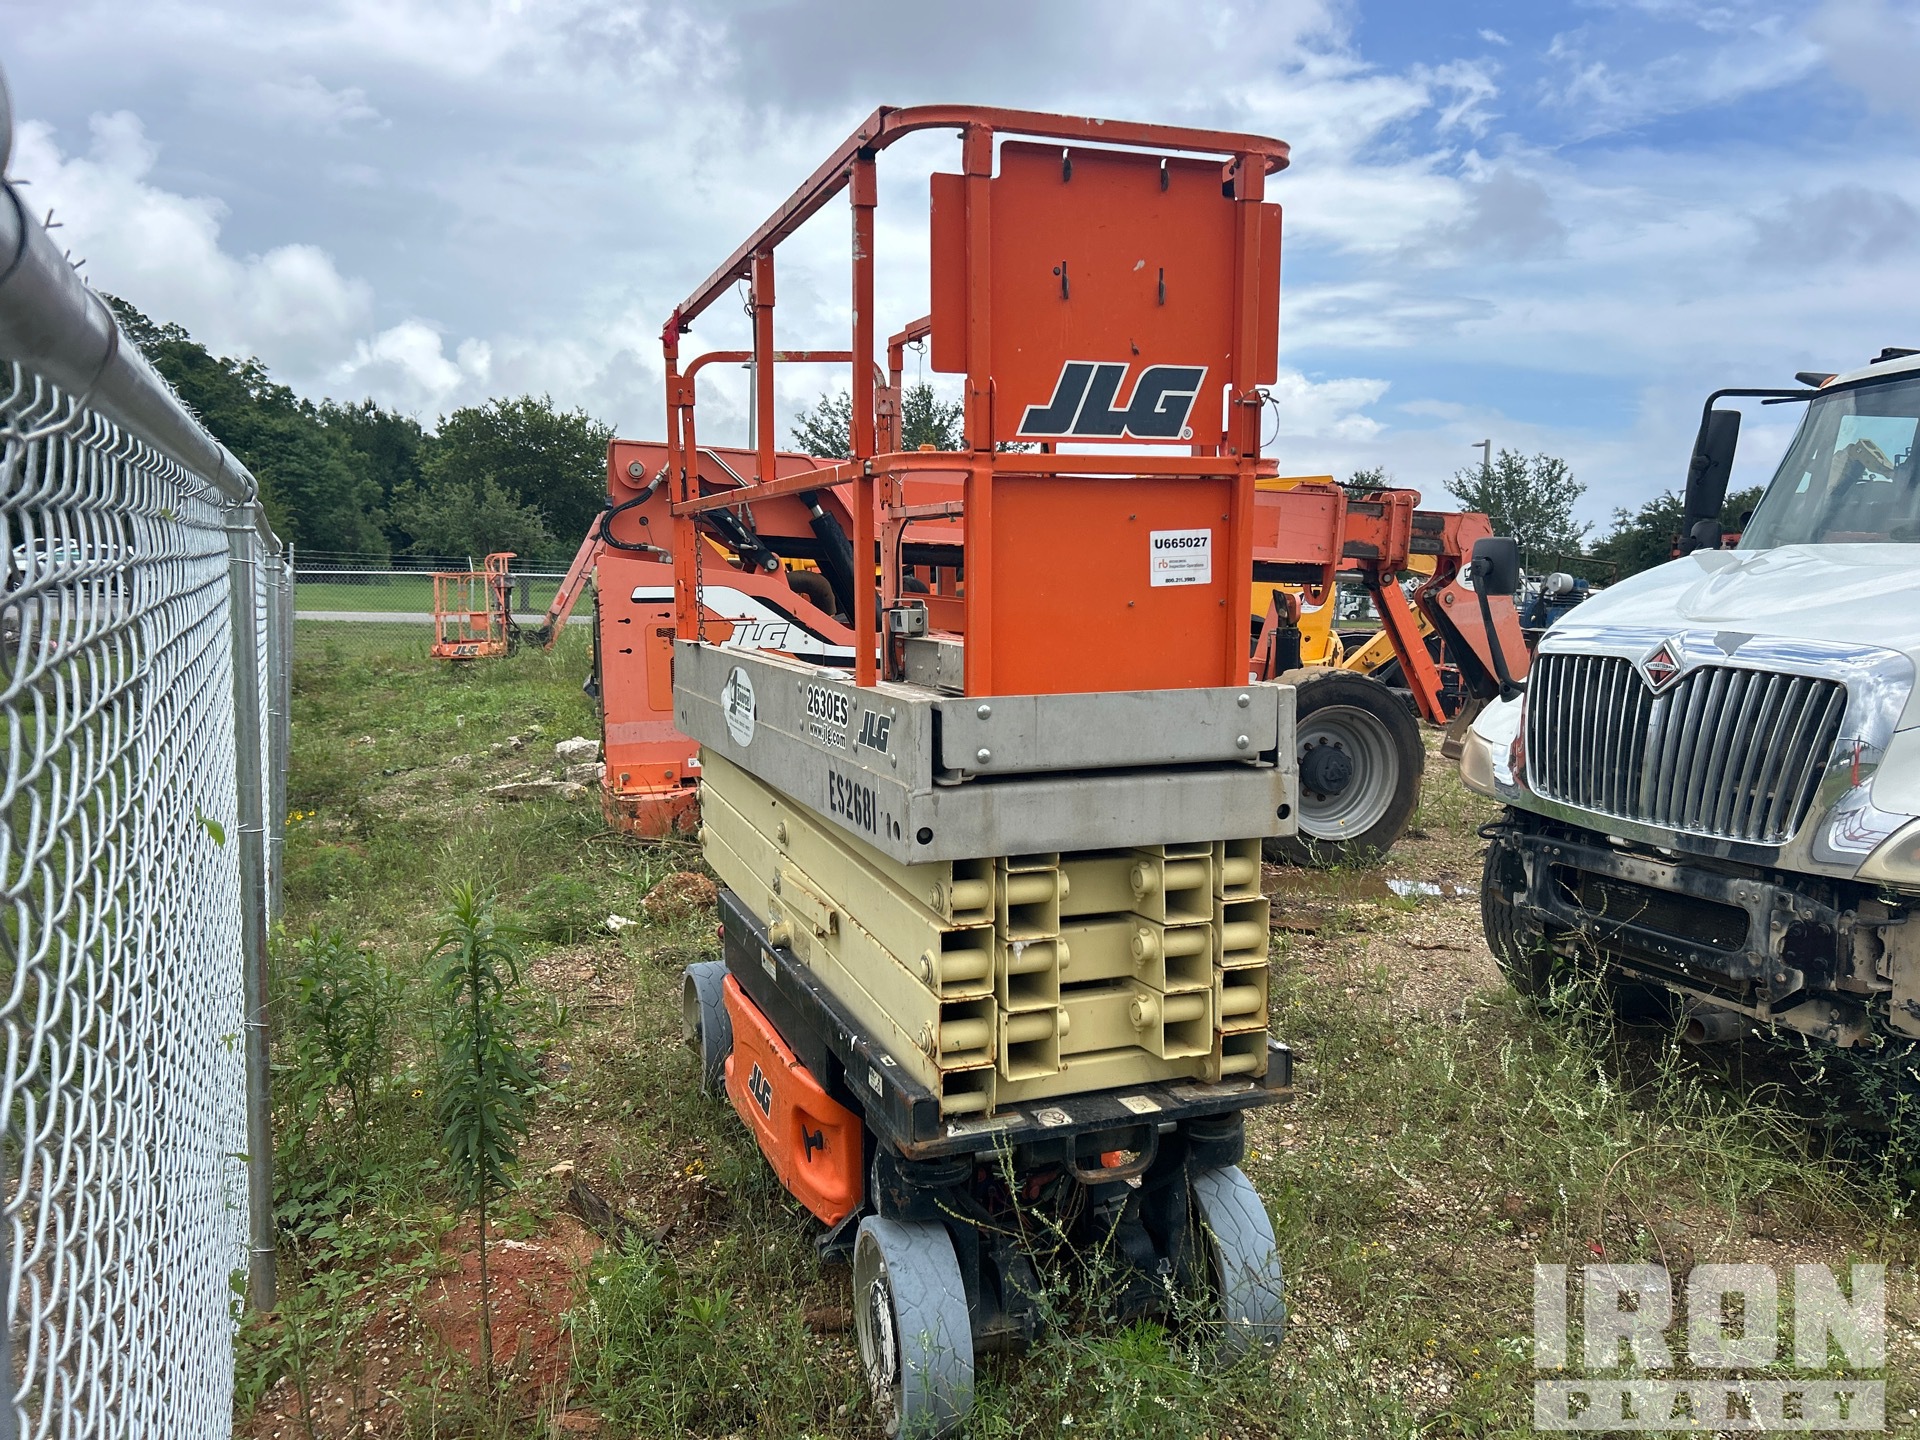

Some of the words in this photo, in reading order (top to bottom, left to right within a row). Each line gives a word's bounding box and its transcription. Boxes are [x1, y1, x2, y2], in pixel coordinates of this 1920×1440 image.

[1017, 361, 1208, 439] JLG
[1155, 537, 1207, 549] U665027
[452, 645, 479, 655] JLG
[720, 623, 790, 649] JLG
[807, 686, 848, 727] 2630ES
[809, 723, 847, 749] www.jlg.com
[859, 710, 890, 754] JLG
[748, 1061, 773, 1120] JLG
